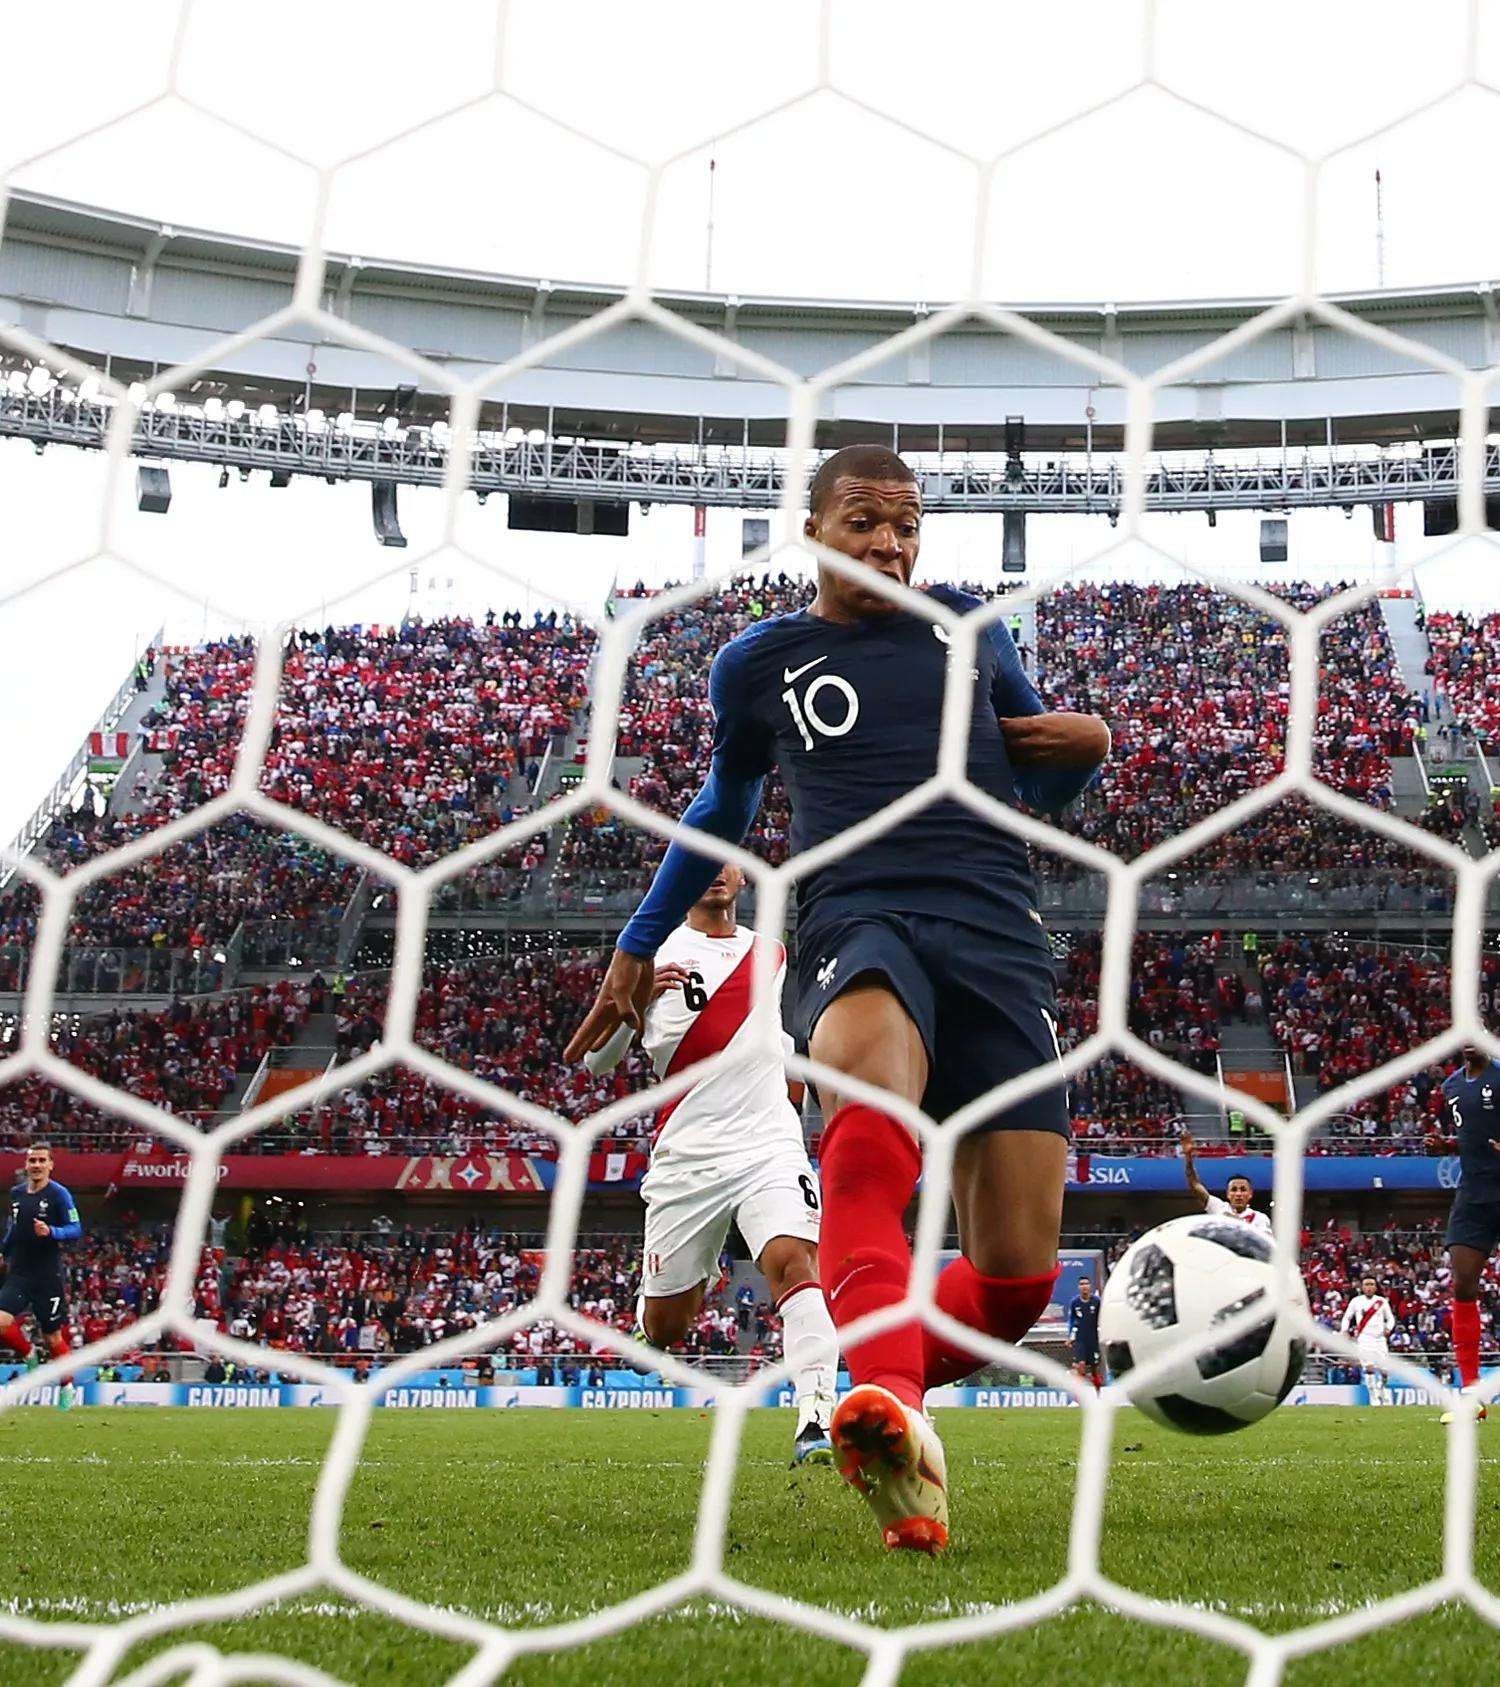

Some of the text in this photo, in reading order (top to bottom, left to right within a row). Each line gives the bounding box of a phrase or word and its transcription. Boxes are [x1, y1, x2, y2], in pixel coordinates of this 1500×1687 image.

[782, 674, 859, 752] 10
[682, 971, 708, 1012] 6
[123, 1160, 229, 1182] #worldp
[49, 1296, 61, 1315] 7
[188, 1387, 281, 1408] GAZPROM
[384, 1388, 477, 1409] GAZPROM
[581, 1389, 674, 1409] GAZPROM
